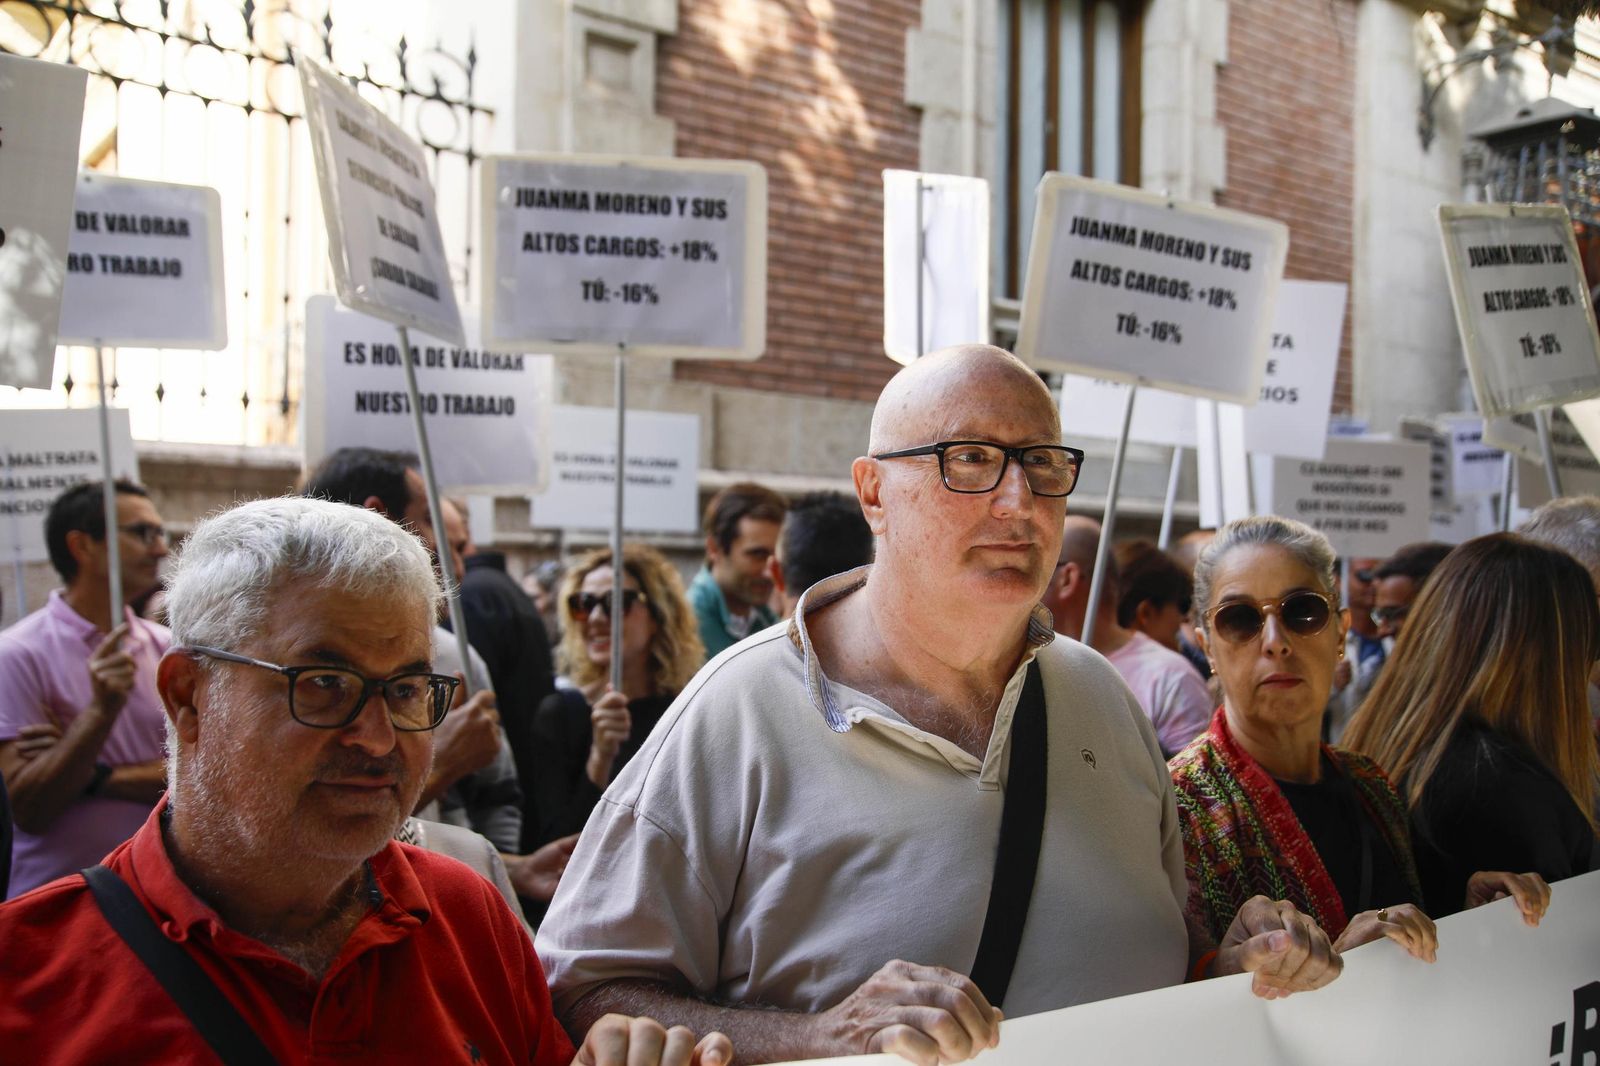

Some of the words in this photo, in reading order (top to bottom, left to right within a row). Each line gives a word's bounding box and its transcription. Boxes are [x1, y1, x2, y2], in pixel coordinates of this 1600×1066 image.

[515, 188, 591, 212] JUANMA
[594, 191, 672, 216] MORENO
[676, 197, 688, 218] Y
[691, 198, 728, 220] SUS
[75, 210, 99, 232] DE
[104, 212, 191, 237] VALORAR
[522, 232, 580, 254] ALTOS
[585, 236, 666, 258] CARGOS:
[669, 240, 718, 262] +18%
[1070, 216, 1136, 247] JUANMA
[1140, 230, 1206, 261] MORENO
[1209, 244, 1220, 264] Y
[1221, 247, 1252, 271] SUS
[98, 254, 182, 278] TRABAJO
[580, 277, 610, 301] TÚ:
[613, 283, 659, 304] -16%
[1071, 259, 1122, 287] ALTOS
[1125, 270, 1194, 302] CARGOS:
[1197, 287, 1238, 311] +18%
[1116, 312, 1141, 337] TÚ:
[1144, 320, 1183, 345] -16%
[344, 342, 366, 364] ES
[371, 343, 421, 367] HOA
[425, 347, 445, 368] DE
[450, 348, 525, 371] VALORAR
[443, 394, 516, 416] TRABAJO
